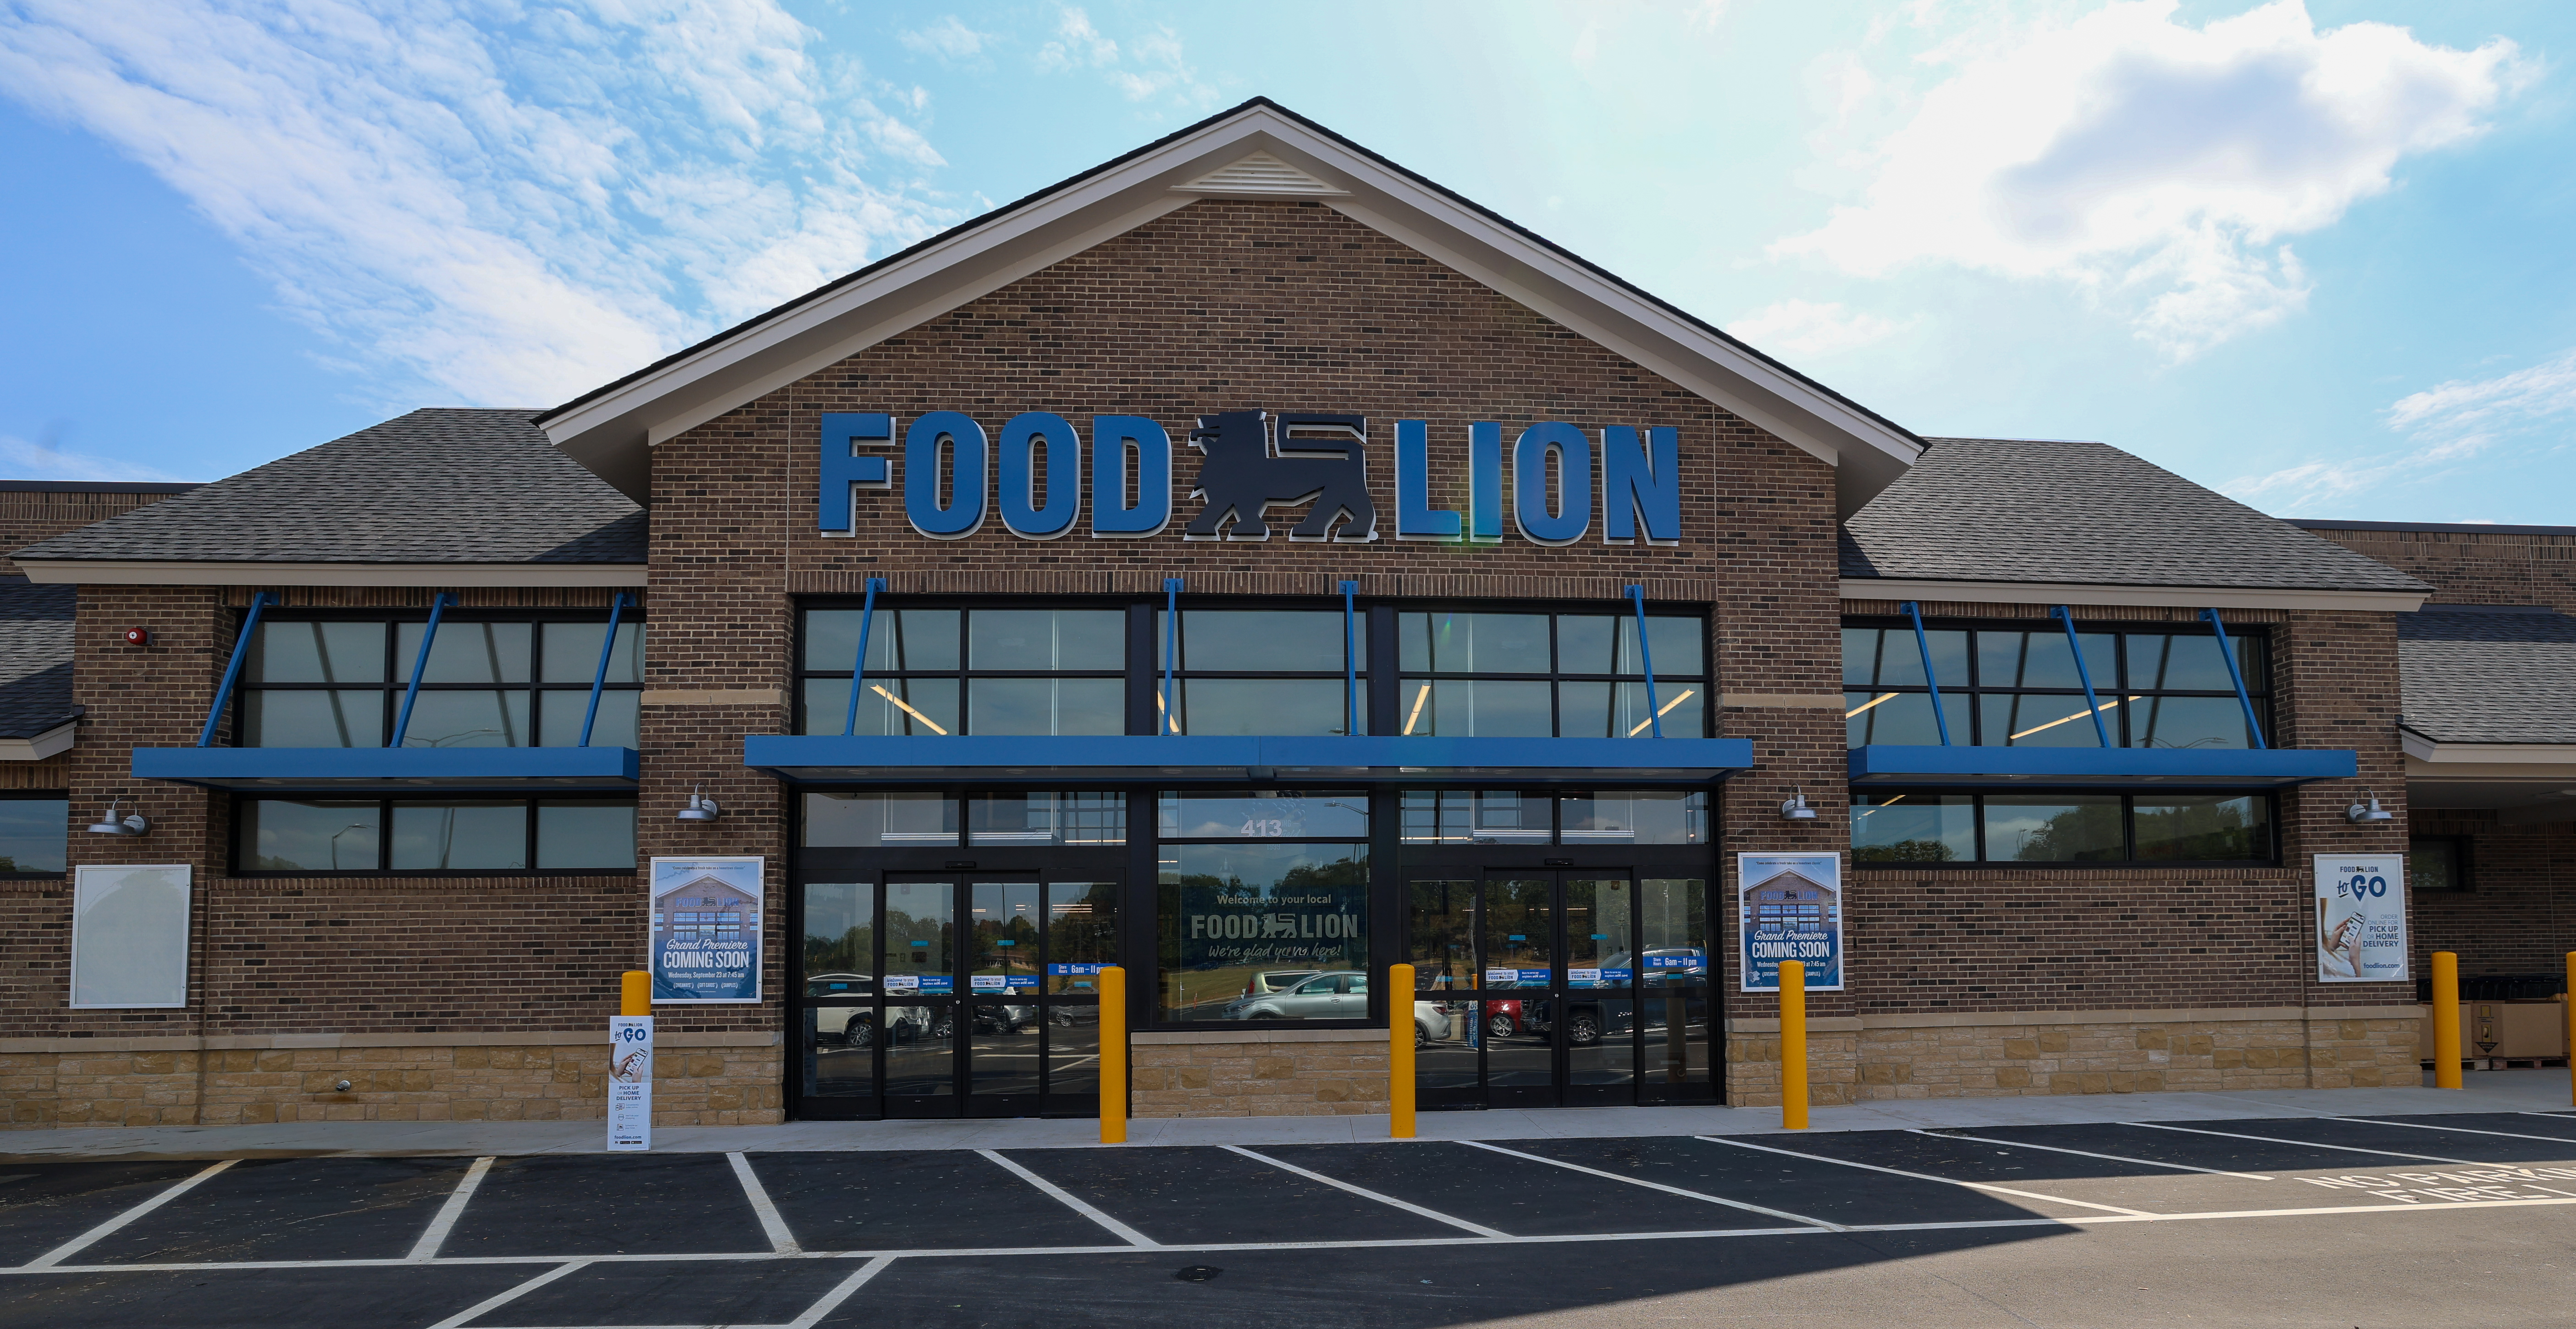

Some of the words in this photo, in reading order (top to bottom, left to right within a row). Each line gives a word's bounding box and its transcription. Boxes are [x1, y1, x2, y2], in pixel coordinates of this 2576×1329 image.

[818, 410, 1172, 541] FOOD
[1394, 419, 1680, 547] LION
[1241, 820, 1282, 837] 413
[1761, 891, 1784, 900] FOOD
[1797, 891, 1818, 900] LION
[2337, 880, 2350, 895] to
[2350, 875, 2386, 902] GO
[675, 897, 702, 908] FOOD
[717, 897, 740, 907] LION
[1217, 895, 1265, 904] Welcome
[1281, 896, 1305, 905] your
[1307, 894, 1331, 903] local
[1192, 915, 1258, 939] FOOD
[1301, 914, 1358, 938] LION
[1754, 930, 1785, 941] Grand
[1786, 930, 1828, 940] Premiere
[666, 939, 701, 950] Grand
[702, 939, 748, 950] Premiere
[1752, 941, 1797, 958] COMING
[1799, 941, 1830, 957] SOON
[663, 951, 713, 968] COMING
[715, 951, 749, 968] SOON
[1208, 945, 1240, 957] We're
[1243, 943, 1274, 963] glad
[1311, 942, 1342, 956] here!
[1071, 965, 1084, 973] 6am
[1665, 958, 1677, 966] 6am
[614, 1031, 623, 1039] to
[624, 1028, 646, 1043] GO
[2293, 1175, 2401, 1189] NO
[2366, 1185, 2553, 1203] FIRE
